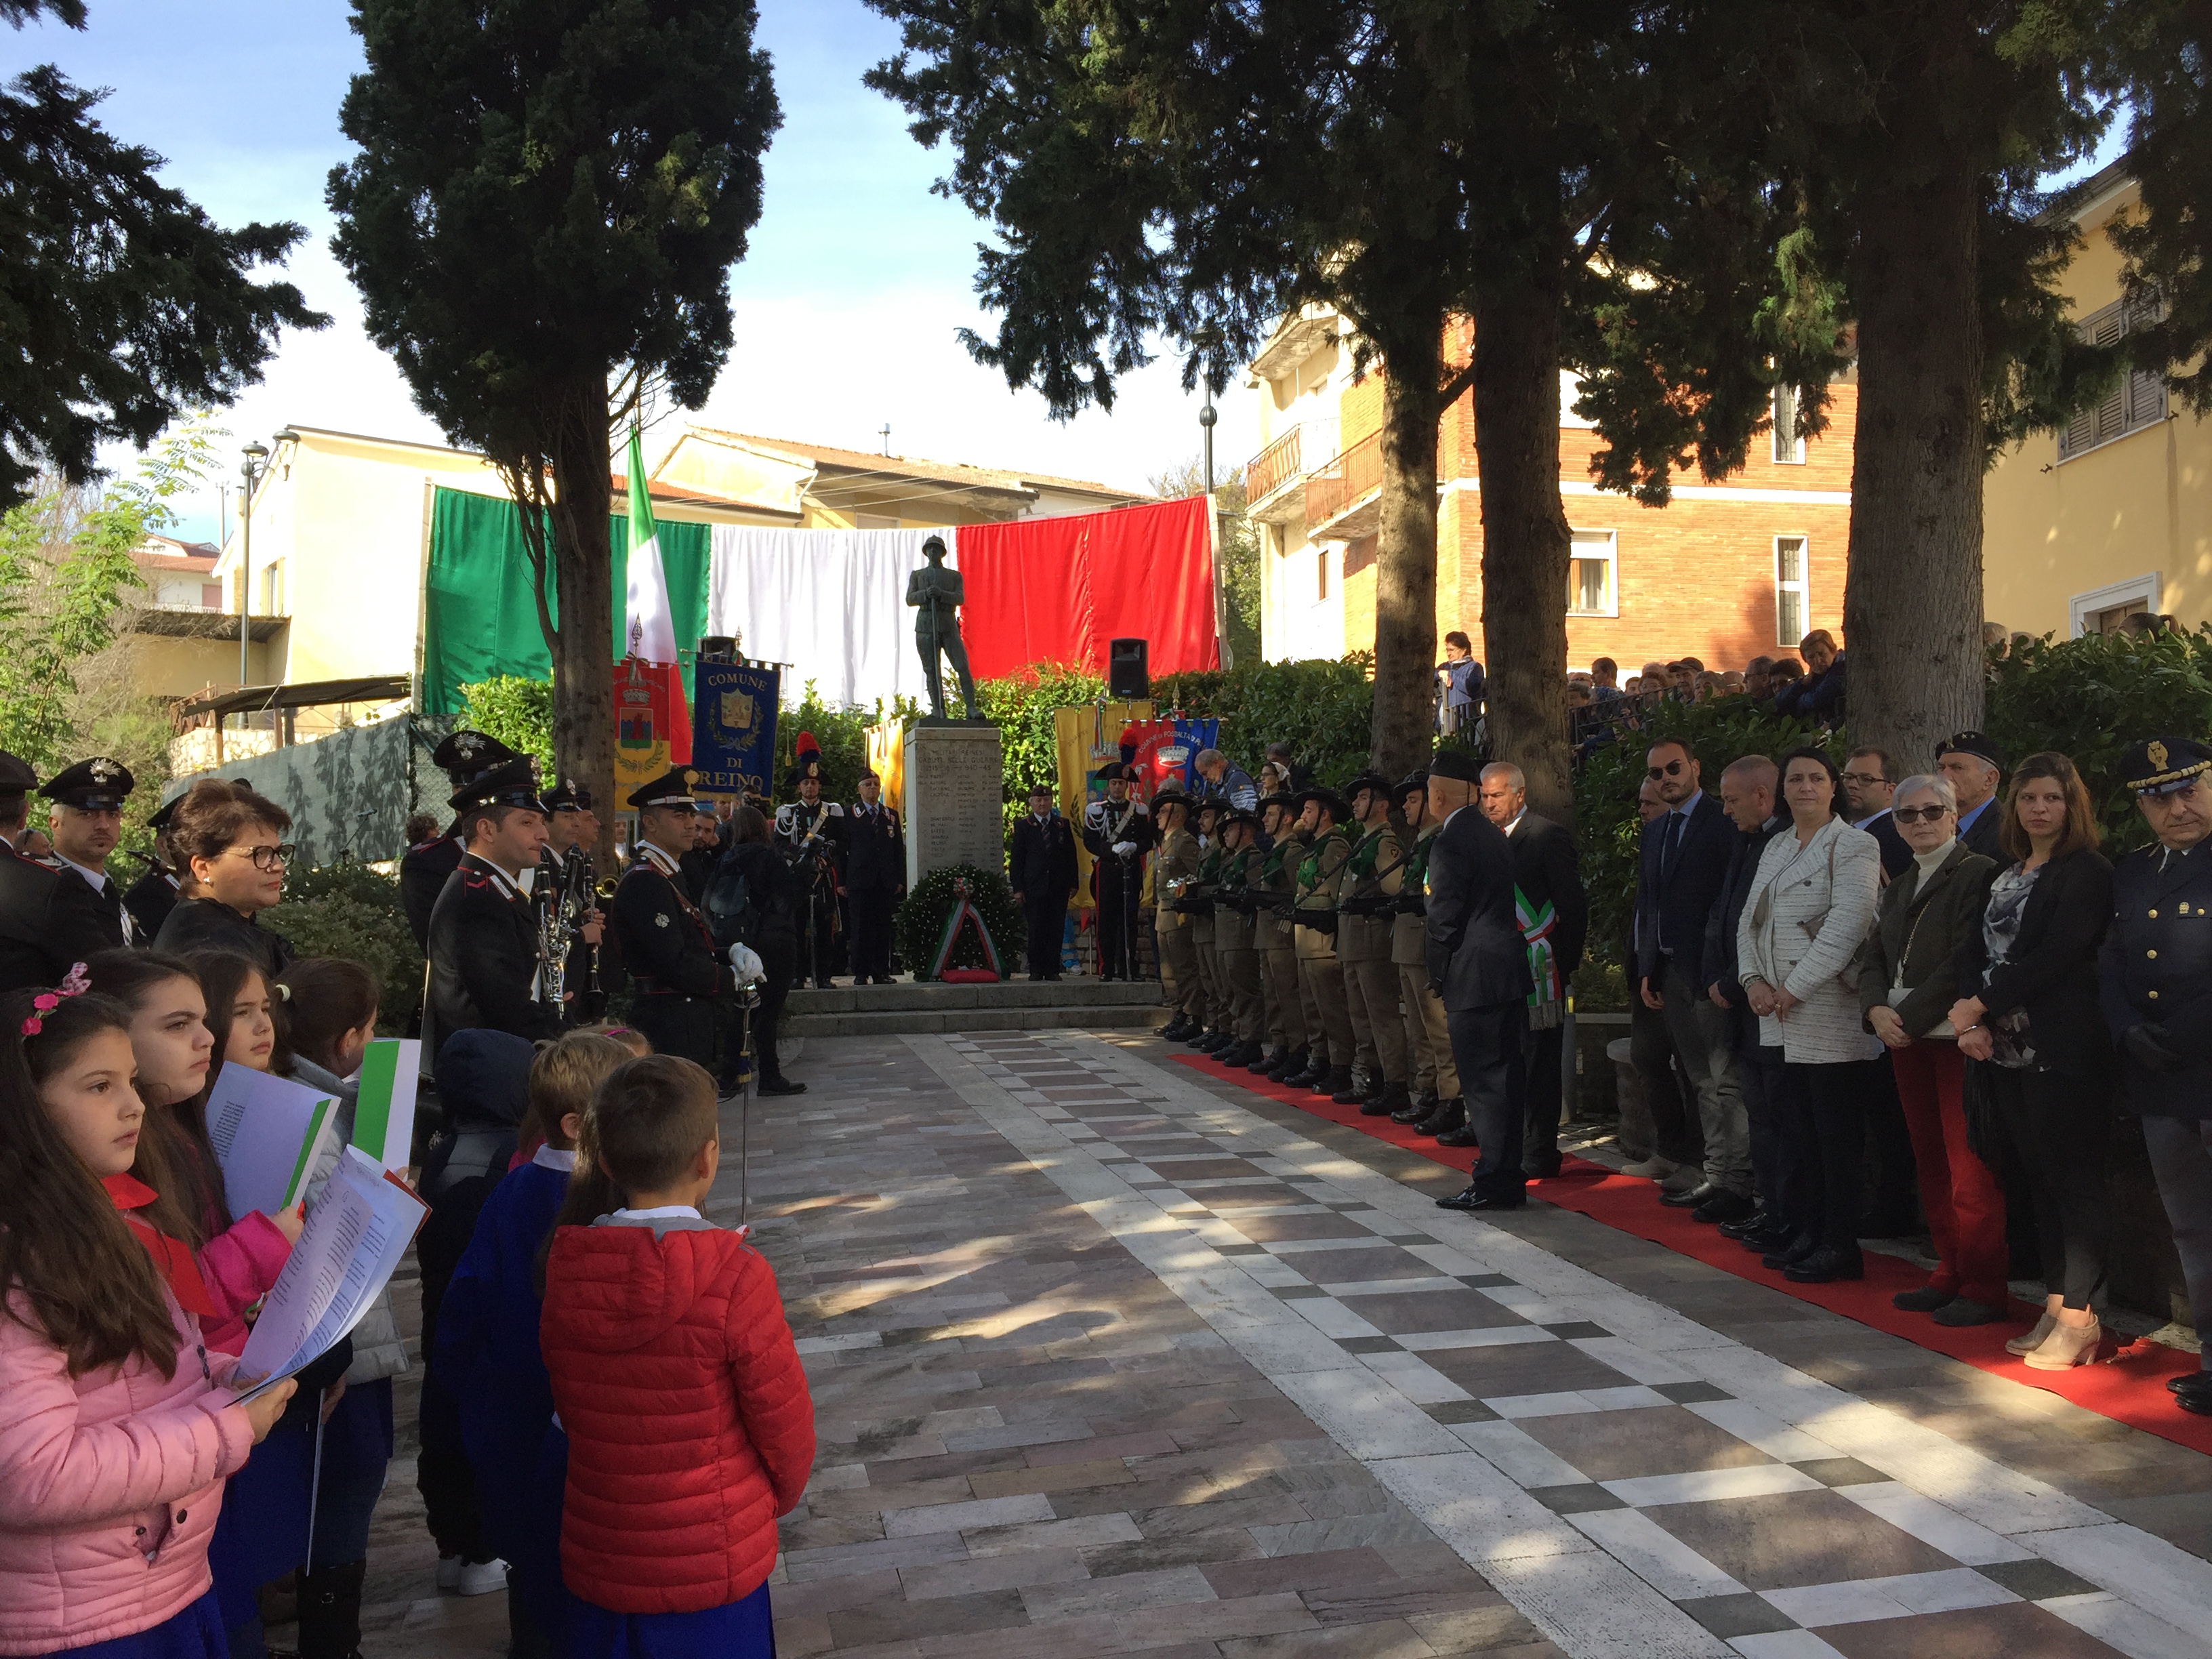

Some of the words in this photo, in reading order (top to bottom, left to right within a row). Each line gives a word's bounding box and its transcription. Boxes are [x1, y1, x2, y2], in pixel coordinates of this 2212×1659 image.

[708, 673, 768, 692] COMUNE
[726, 757, 743, 769] DI
[699, 771, 764, 791] REINO
